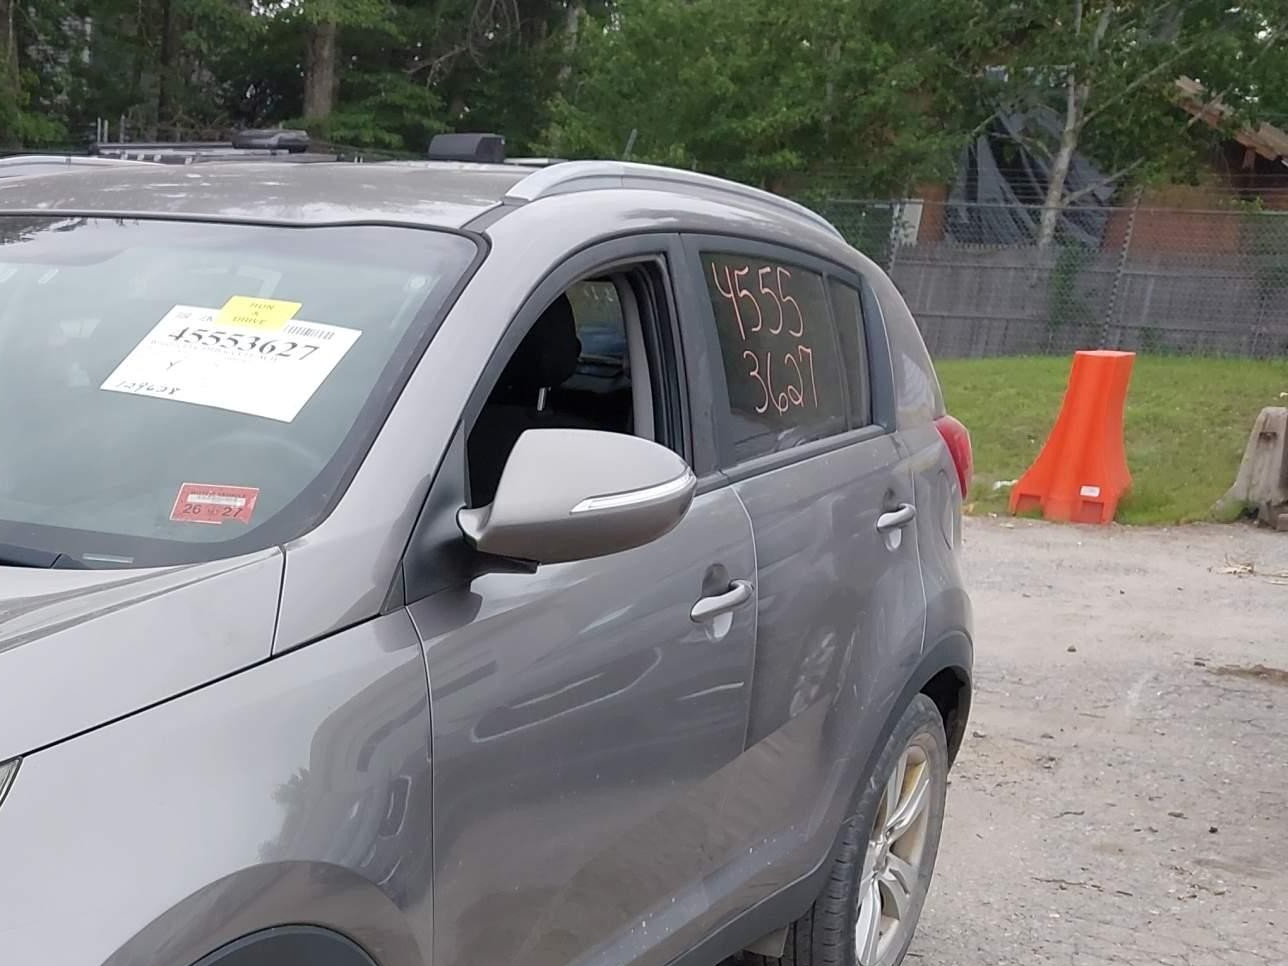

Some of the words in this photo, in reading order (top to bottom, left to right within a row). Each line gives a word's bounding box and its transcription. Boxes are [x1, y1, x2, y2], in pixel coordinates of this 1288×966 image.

[711, 262, 804, 340] 4555
[168, 326, 321, 361] 45553627
[743, 345, 818, 416] 3627
[182, 503, 202, 515] 26
[221, 506, 244, 518] 27
